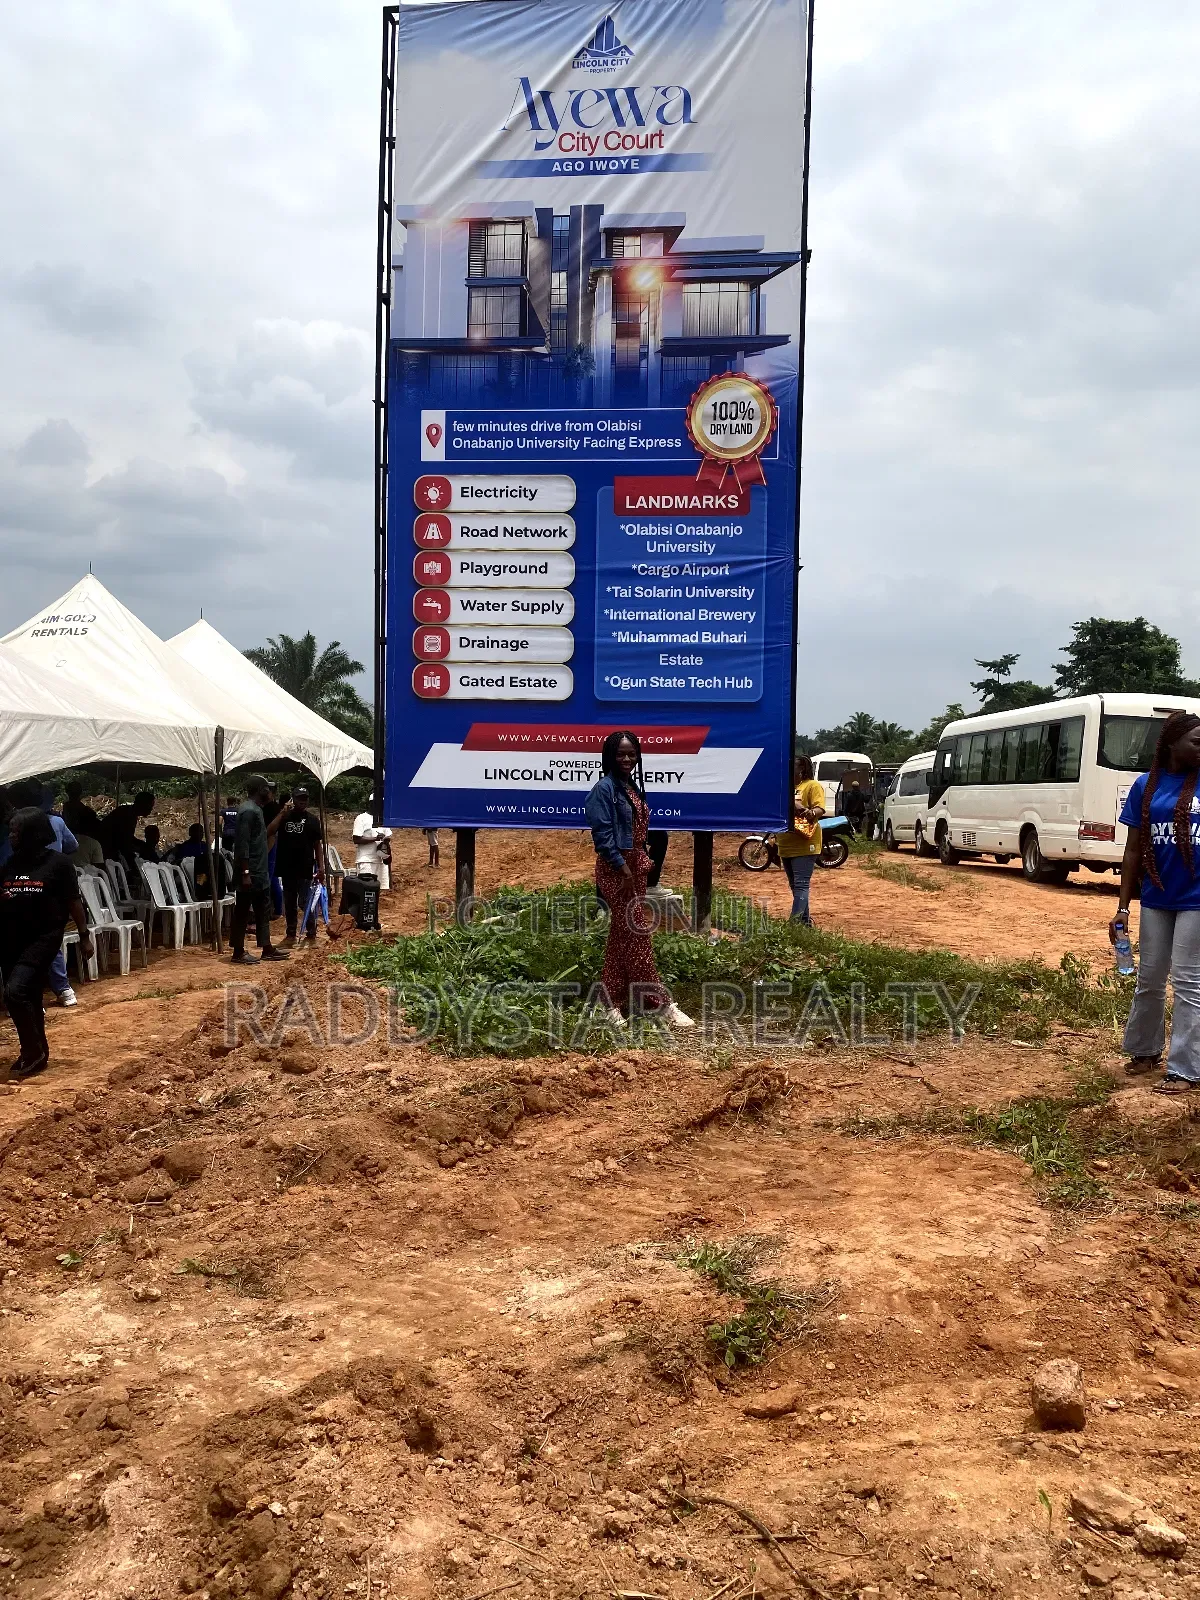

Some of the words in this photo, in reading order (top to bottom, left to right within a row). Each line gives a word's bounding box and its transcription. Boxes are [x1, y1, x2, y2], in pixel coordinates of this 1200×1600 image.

[571, 58, 610, 69] LINCOLN
[610, 57, 630, 67] CITY
[498, 76, 698, 151] Ayewa
[558, 131, 600, 156] City
[603, 129, 665, 151] Court
[552, 160, 585, 172] AGO
[589, 158, 640, 171] IWOYE
[710, 400, 755, 422] 100%
[452, 420, 475, 433] few
[477, 420, 528, 432] minutes
[530, 419, 562, 432] drive
[564, 419, 594, 431] from
[596, 418, 642, 432] Olabisi
[709, 422, 728, 436] DRY
[729, 422, 753, 435] LAND
[452, 436, 514, 451] Onabanjo
[516, 436, 580, 450] University
[583, 435, 626, 451] Facing
[629, 435, 682, 450] Express
[460, 485, 539, 501] Electricity
[625, 494, 739, 509] LANDMARKS
[460, 525, 499, 538] Road
[502, 525, 568, 538] Network
[675, 523, 743, 538] Onabanjo
[646, 540, 716, 556] University
[460, 561, 549, 577] Playground
[681, 562, 730, 578] Airport
[634, 585, 683, 598] Solarin
[685, 585, 755, 601] University
[459, 599, 507, 612] Water
[511, 599, 565, 615] Supply
[698, 608, 756, 624] Brewery
[31, 627, 89, 638] RENTALS
[701, 630, 747, 644] Buhari
[459, 635, 530, 651] Drainage
[659, 653, 704, 666] Estate
[459, 675, 505, 688] Gated
[509, 675, 558, 689] Estate
[649, 675, 686, 689] State
[688, 675, 722, 689] Tech
[724, 675, 753, 689] Hub
[549, 760, 602, 769] POWERED
[484, 768, 552, 782] LINCOLN
[559, 769, 594, 782] CITY
